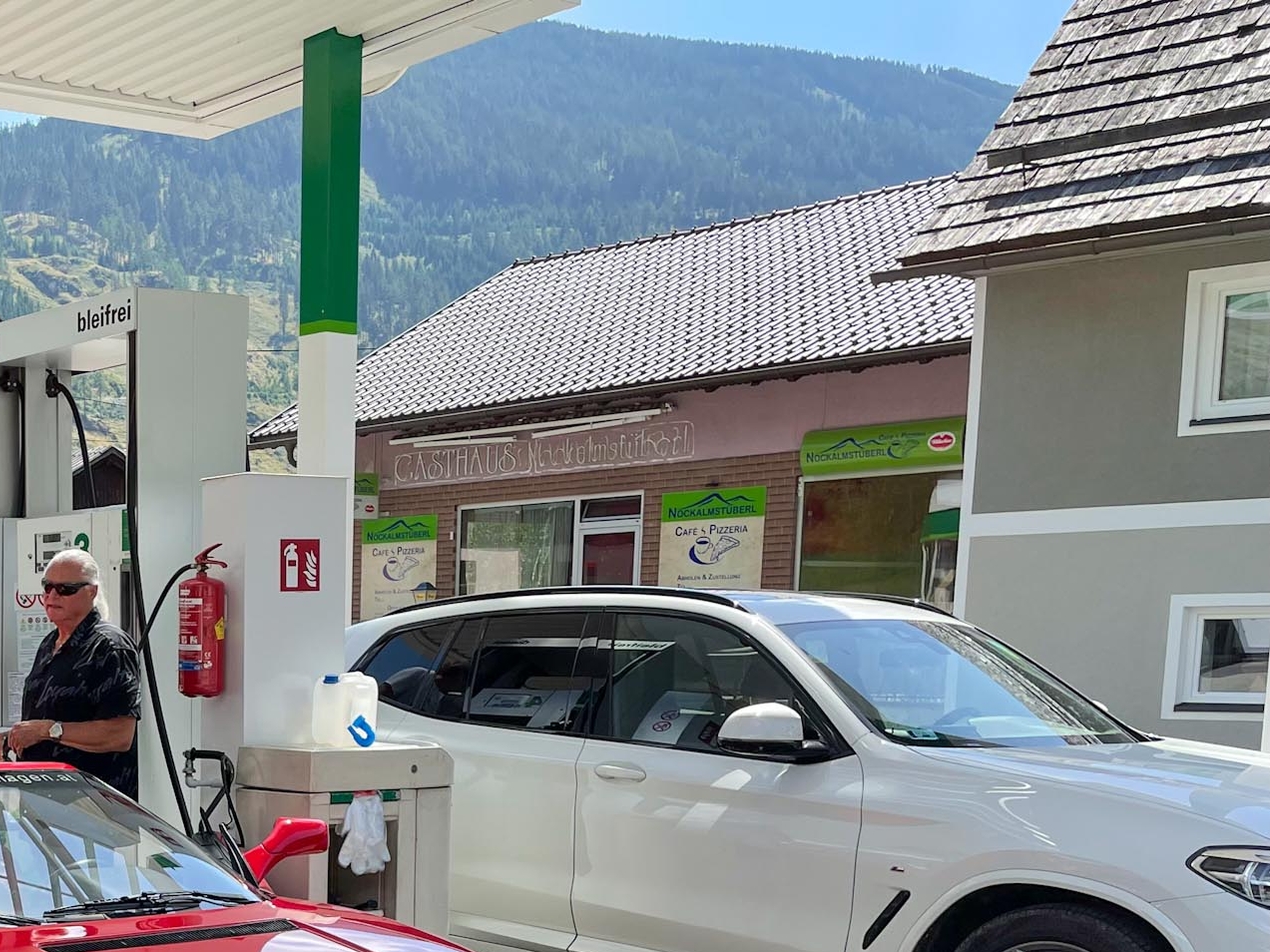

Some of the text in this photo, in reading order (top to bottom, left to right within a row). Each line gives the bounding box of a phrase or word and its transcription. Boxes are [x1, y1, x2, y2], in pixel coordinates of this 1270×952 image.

[77, 298, 132, 333] bleifrei
[394, 442, 518, 482] GASTHAUS
[709, 524, 748, 535] PIZZERIA
